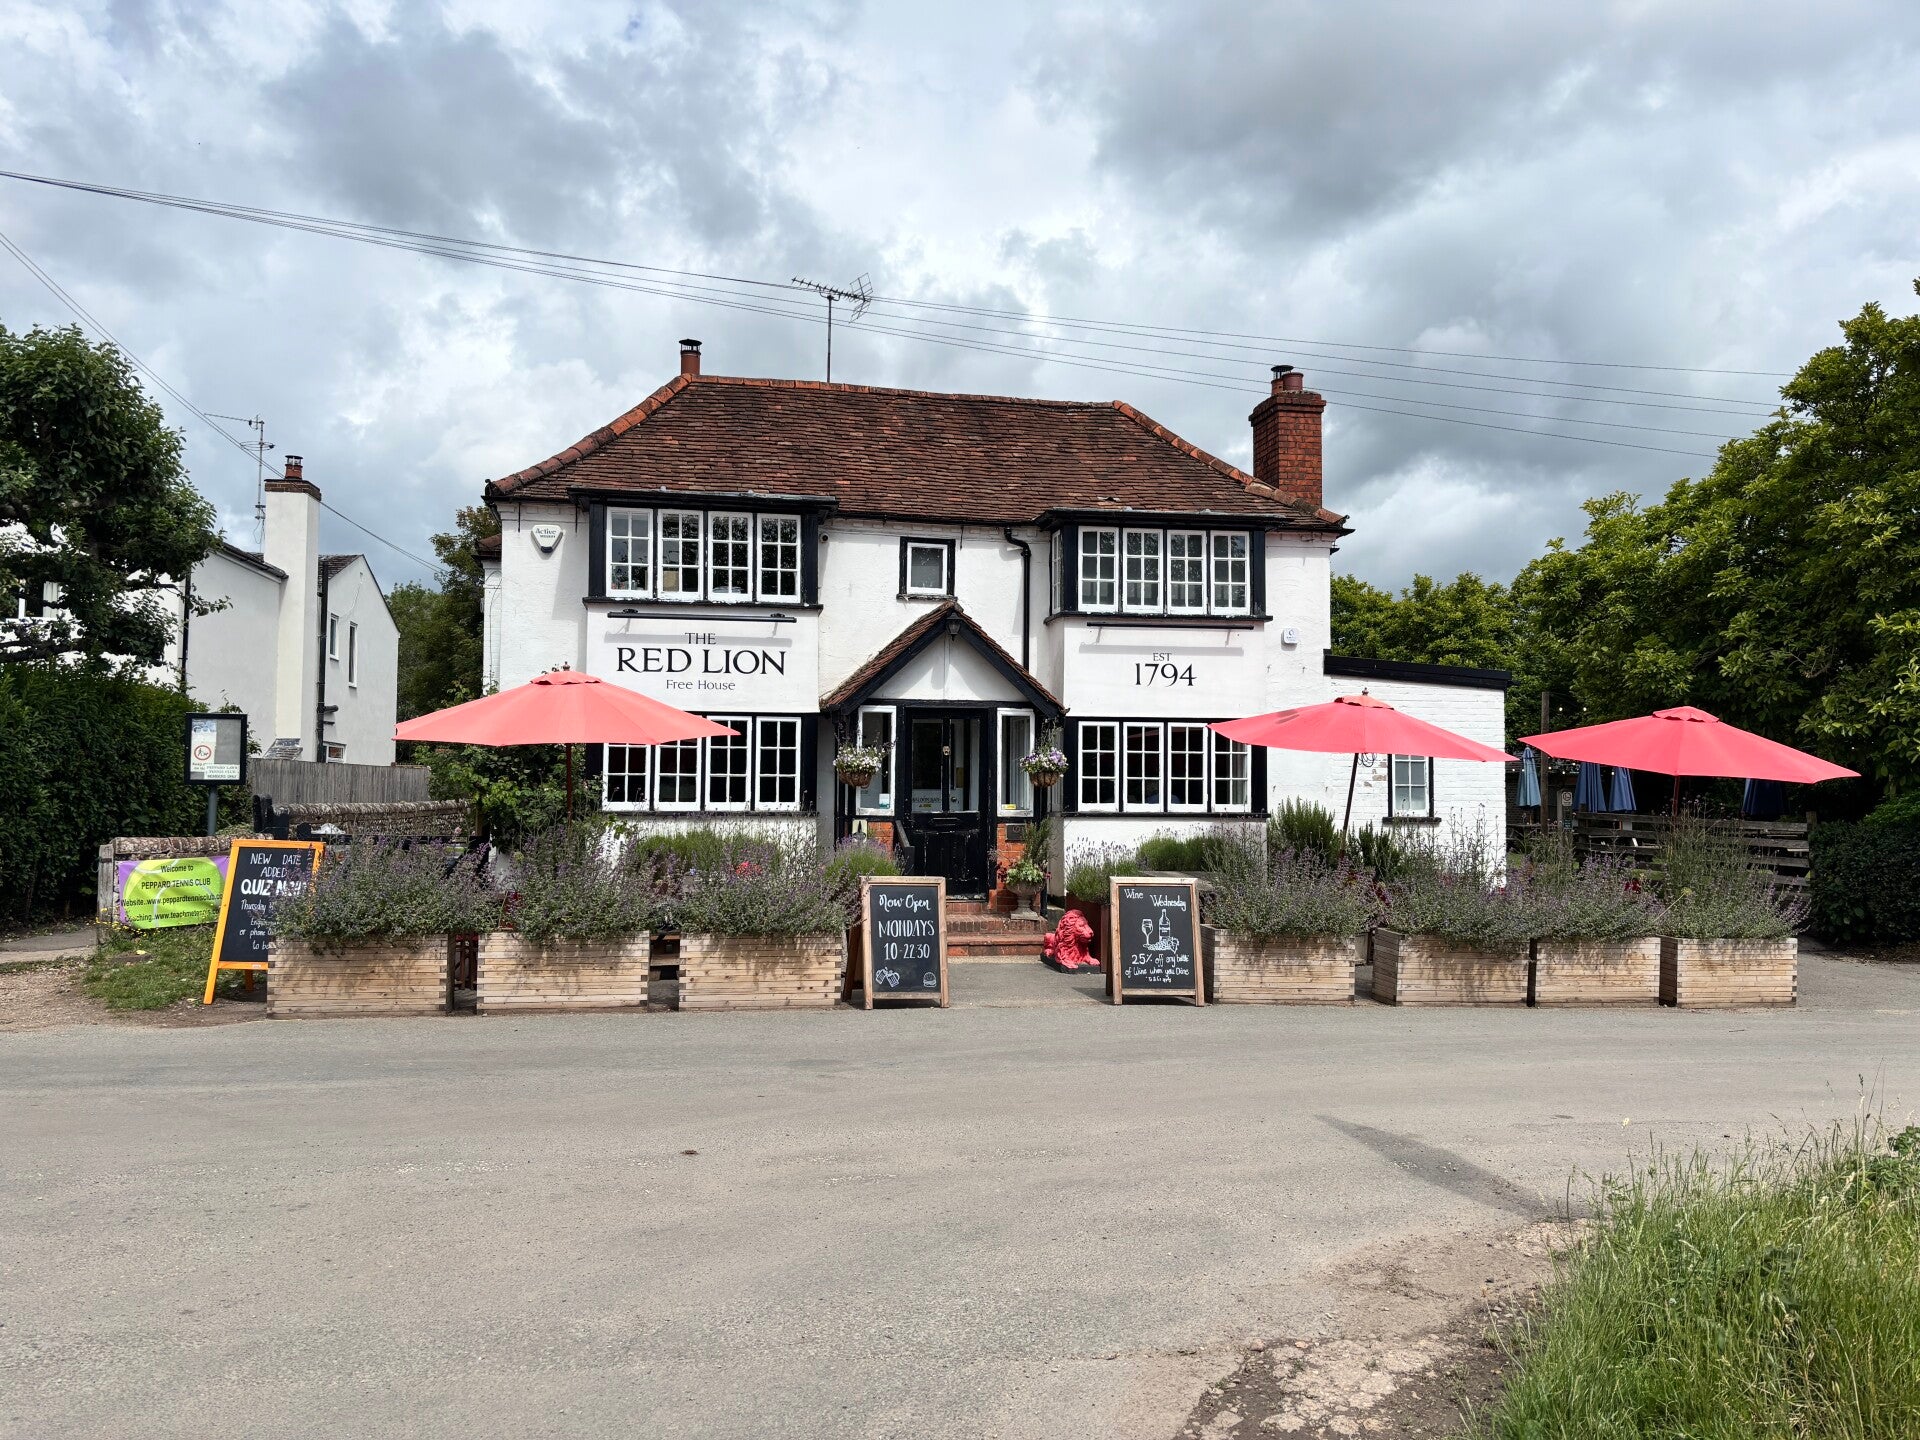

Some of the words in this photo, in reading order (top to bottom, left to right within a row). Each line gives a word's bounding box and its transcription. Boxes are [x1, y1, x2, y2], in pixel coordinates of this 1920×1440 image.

[685, 633, 717, 645] THE
[617, 648, 692, 673] RED
[702, 649, 786, 675] LION
[1153, 653, 1172, 661] EST
[1135, 663, 1198, 687] 1794
[666, 679, 694, 690] Free
[698, 680, 736, 690] House
[250, 853, 272, 865] NEW
[282, 854, 302, 865] DATE
[160, 865, 187, 873] Welcome
[260, 867, 287, 878] ADDED
[141, 880, 171, 890] PEPPARD
[171, 879, 194, 888] TENNIS
[195, 878, 211, 886] CLUB
[240, 879, 273, 896] QUIZ
[1124, 888, 1144, 899] Wine
[241, 899, 266, 914] Thursday
[879, 893, 904, 913] Now
[905, 894, 931, 913] Open
[1150, 894, 1187, 911] Wednesday
[250, 927, 266, 939] phone
[878, 920, 935, 938] MONDAYS
[252, 940, 260, 950] to
[1131, 953, 1153, 965] 25%
[1155, 953, 1164, 967] off
[1165, 956, 1176, 968] any
[1124, 967, 1132, 978] of
[1133, 967, 1148, 976] Wine
[1149, 967, 1163, 975] when
[1164, 969, 1175, 977] you
[1176, 967, 1189, 976] Dine
